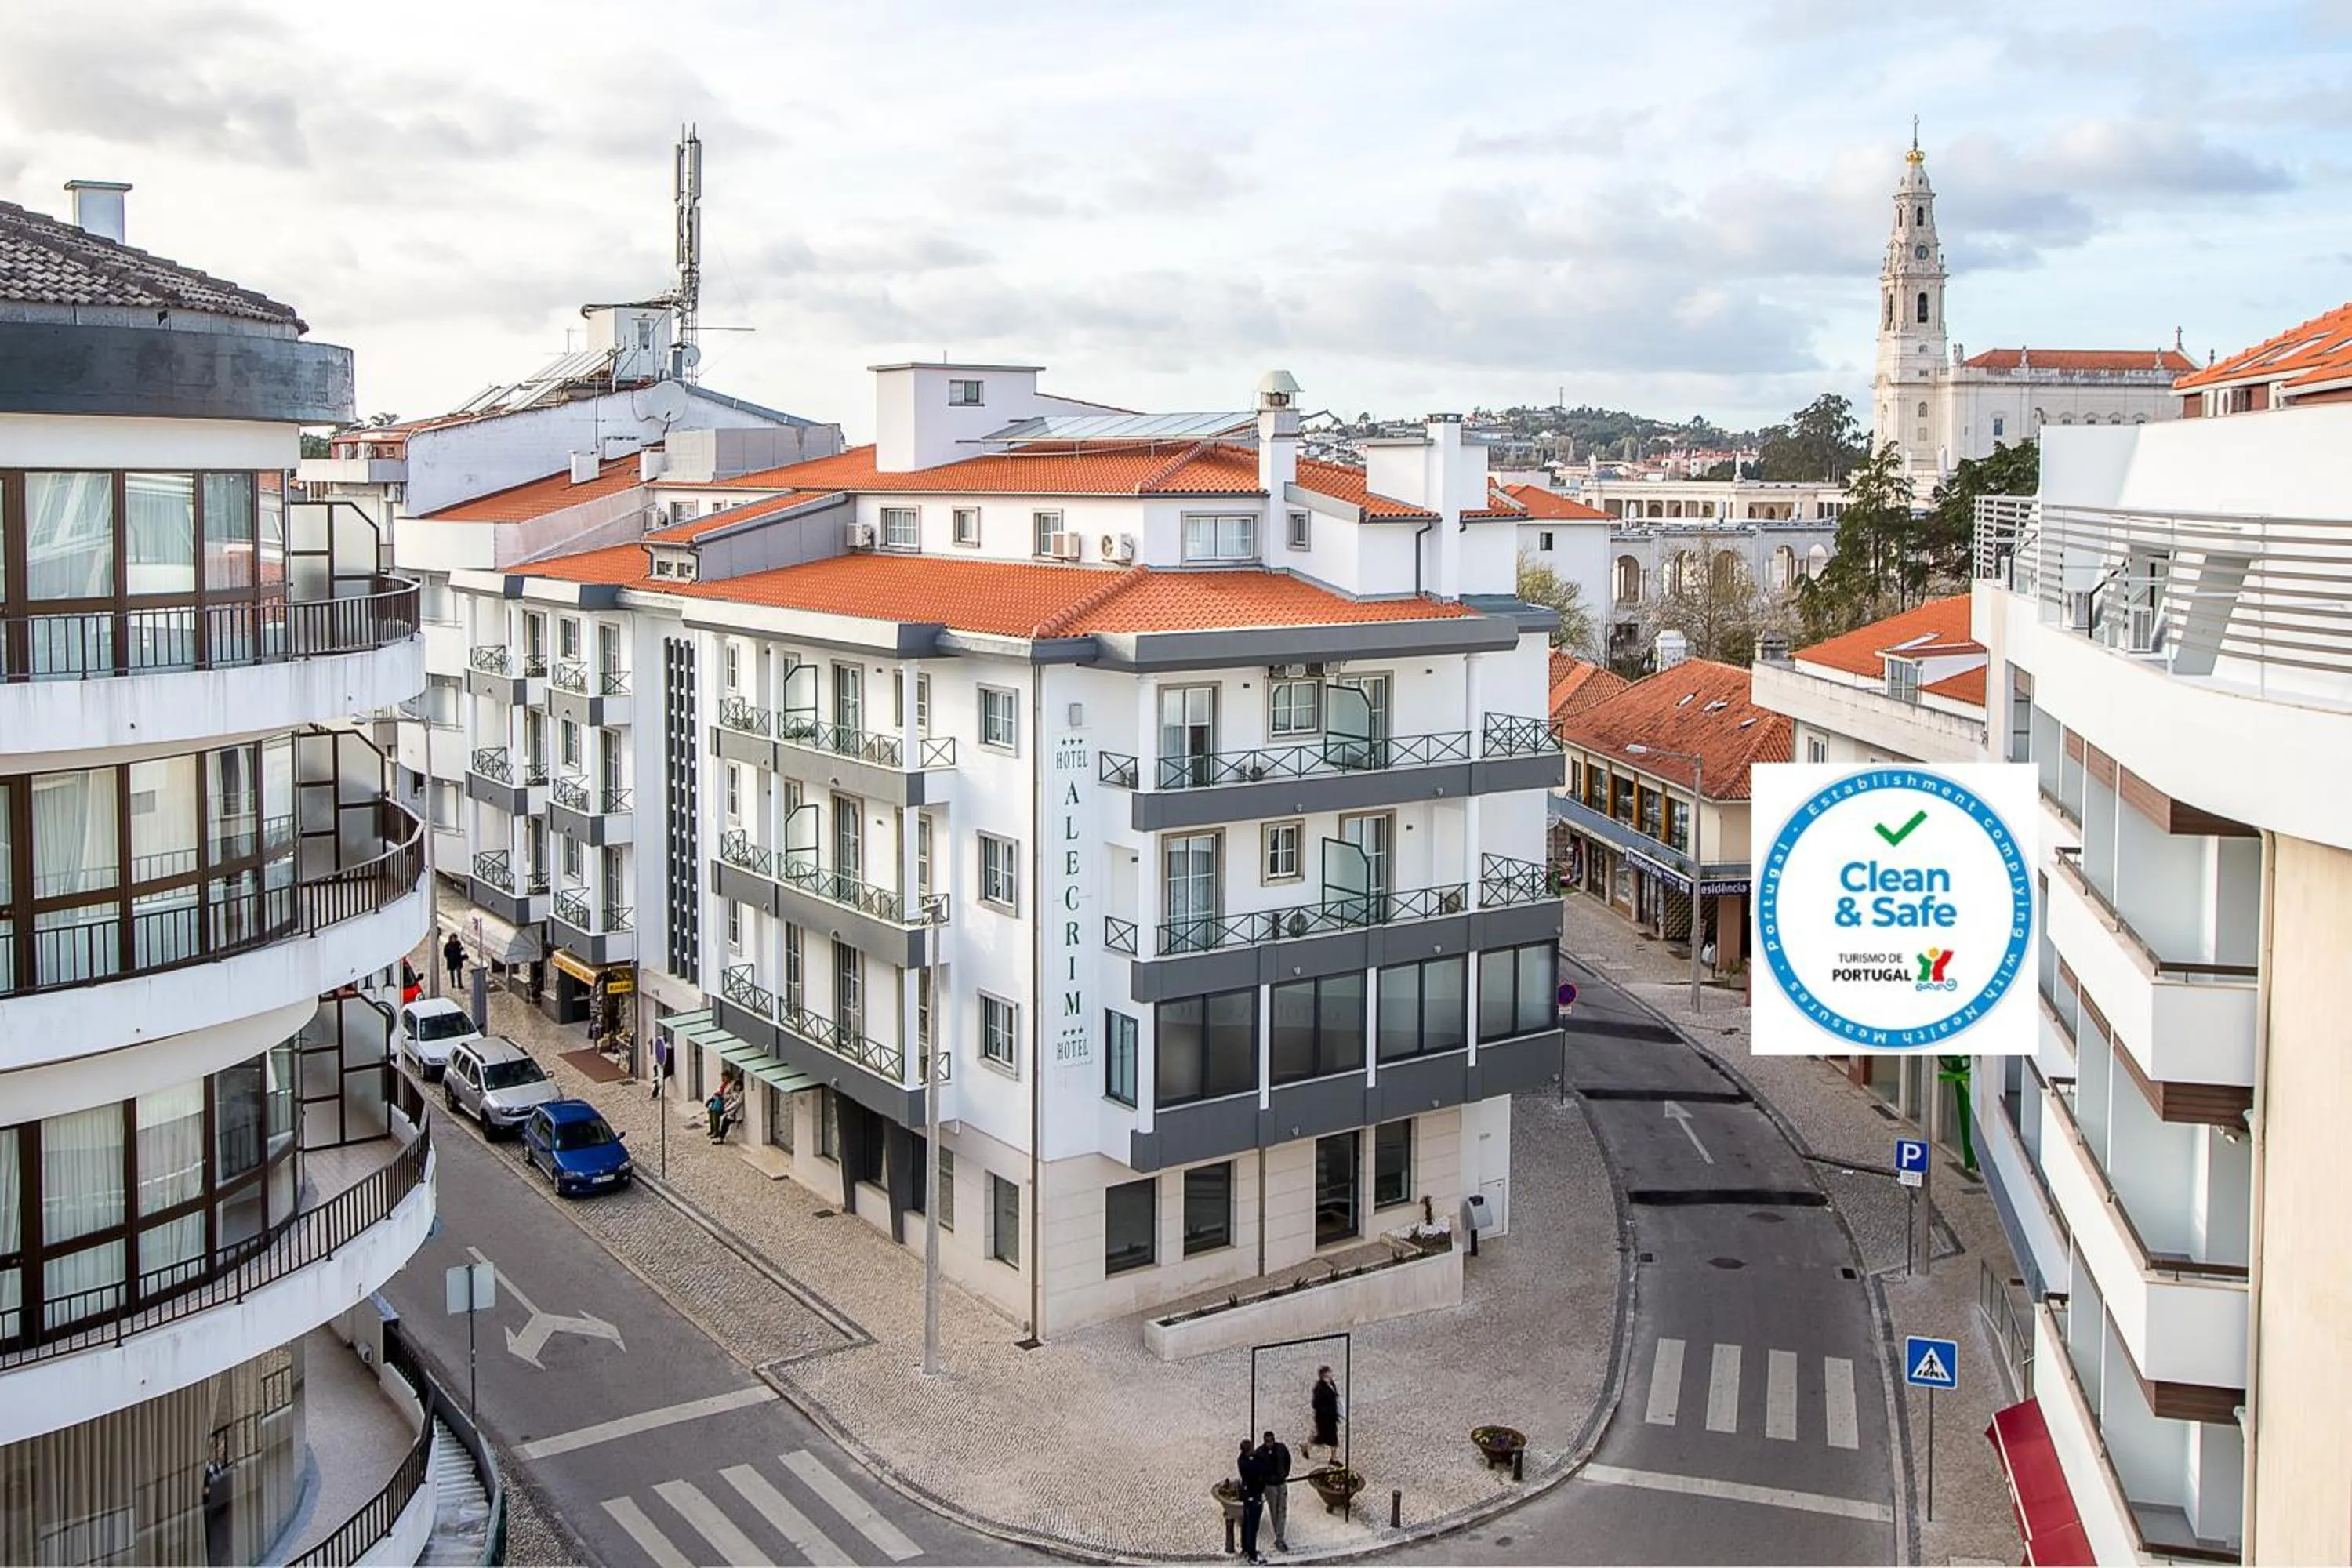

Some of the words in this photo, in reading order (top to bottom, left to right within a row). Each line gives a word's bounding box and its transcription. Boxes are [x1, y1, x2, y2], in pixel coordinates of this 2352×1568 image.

[1056, 750, 1088, 769] HOTEL
[1063, 780, 1081, 1016] ALECRIM
[1699, 882, 1748, 895] esidência
[1056, 1039, 1089, 1060] HOTEL
[1901, 1143, 1922, 1167] P
